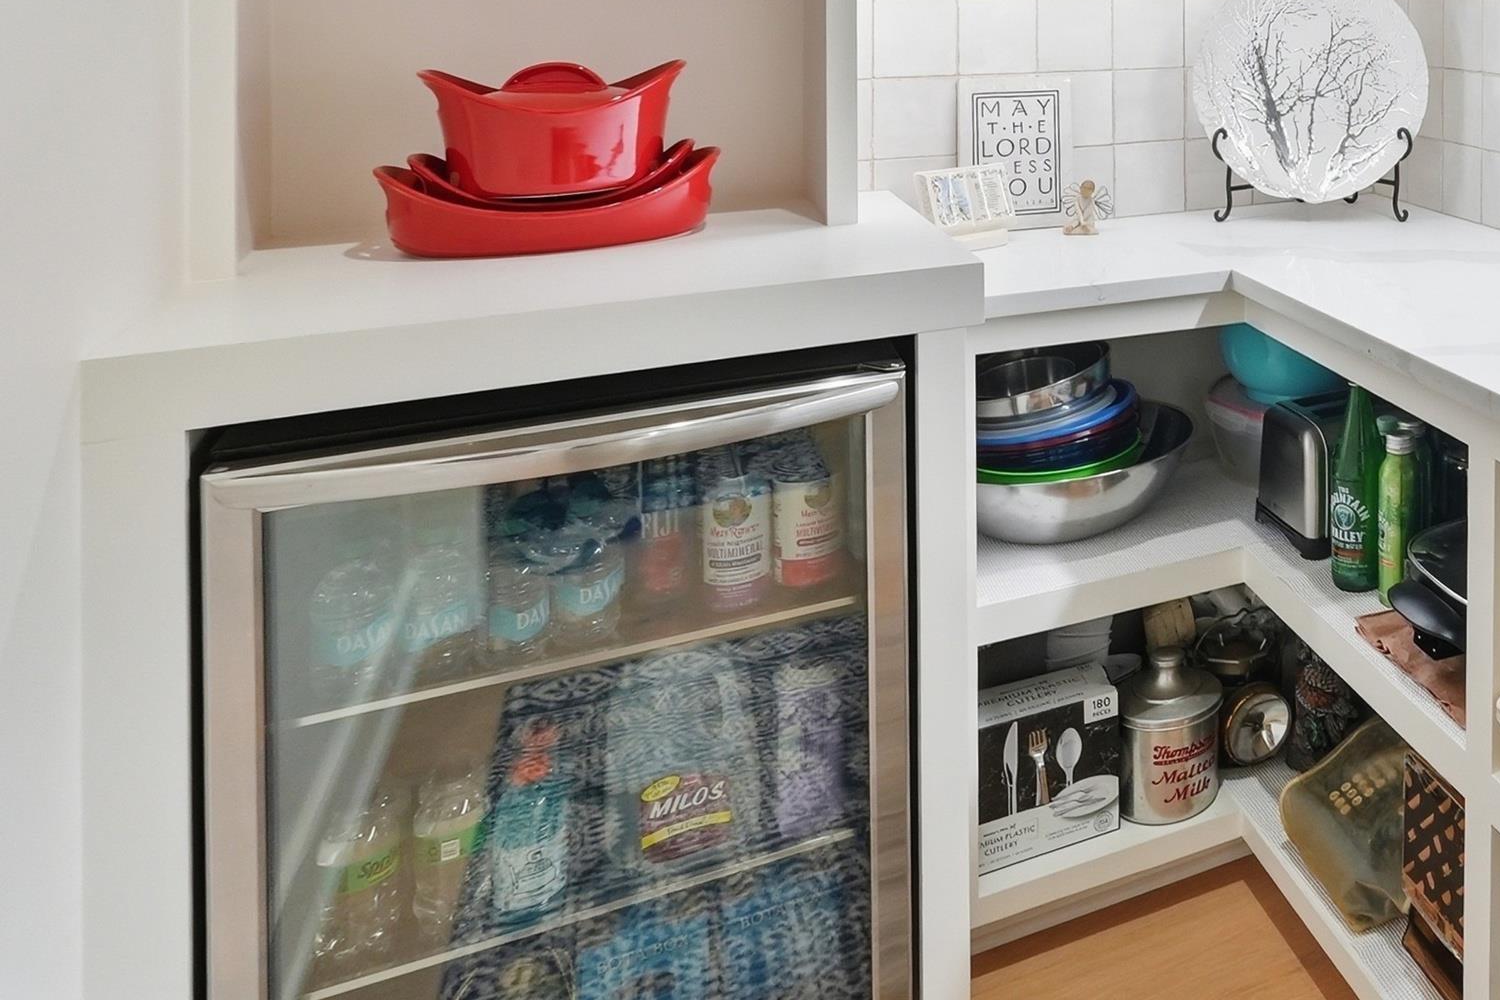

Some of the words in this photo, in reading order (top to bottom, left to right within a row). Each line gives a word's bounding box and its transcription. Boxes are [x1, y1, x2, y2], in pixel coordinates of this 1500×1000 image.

[981, 99, 1050, 117] MAY
[982, 137, 1051, 158] LORD
[1014, 159, 1052, 174] ESS
[1008, 177, 1053, 196] OU
[641, 511, 679, 539] FIJI
[580, 573, 622, 604] DASA
[405, 610, 467, 640] DASAN
[517, 601, 548, 630] DAS
[337, 620, 393, 651] DASA
[1007, 689, 1058, 708] CUTLERY
[1092, 697, 1111, 710] 180
[1164, 776, 1210, 803] Milk
[1005, 825, 1035, 841] PLASTIC
